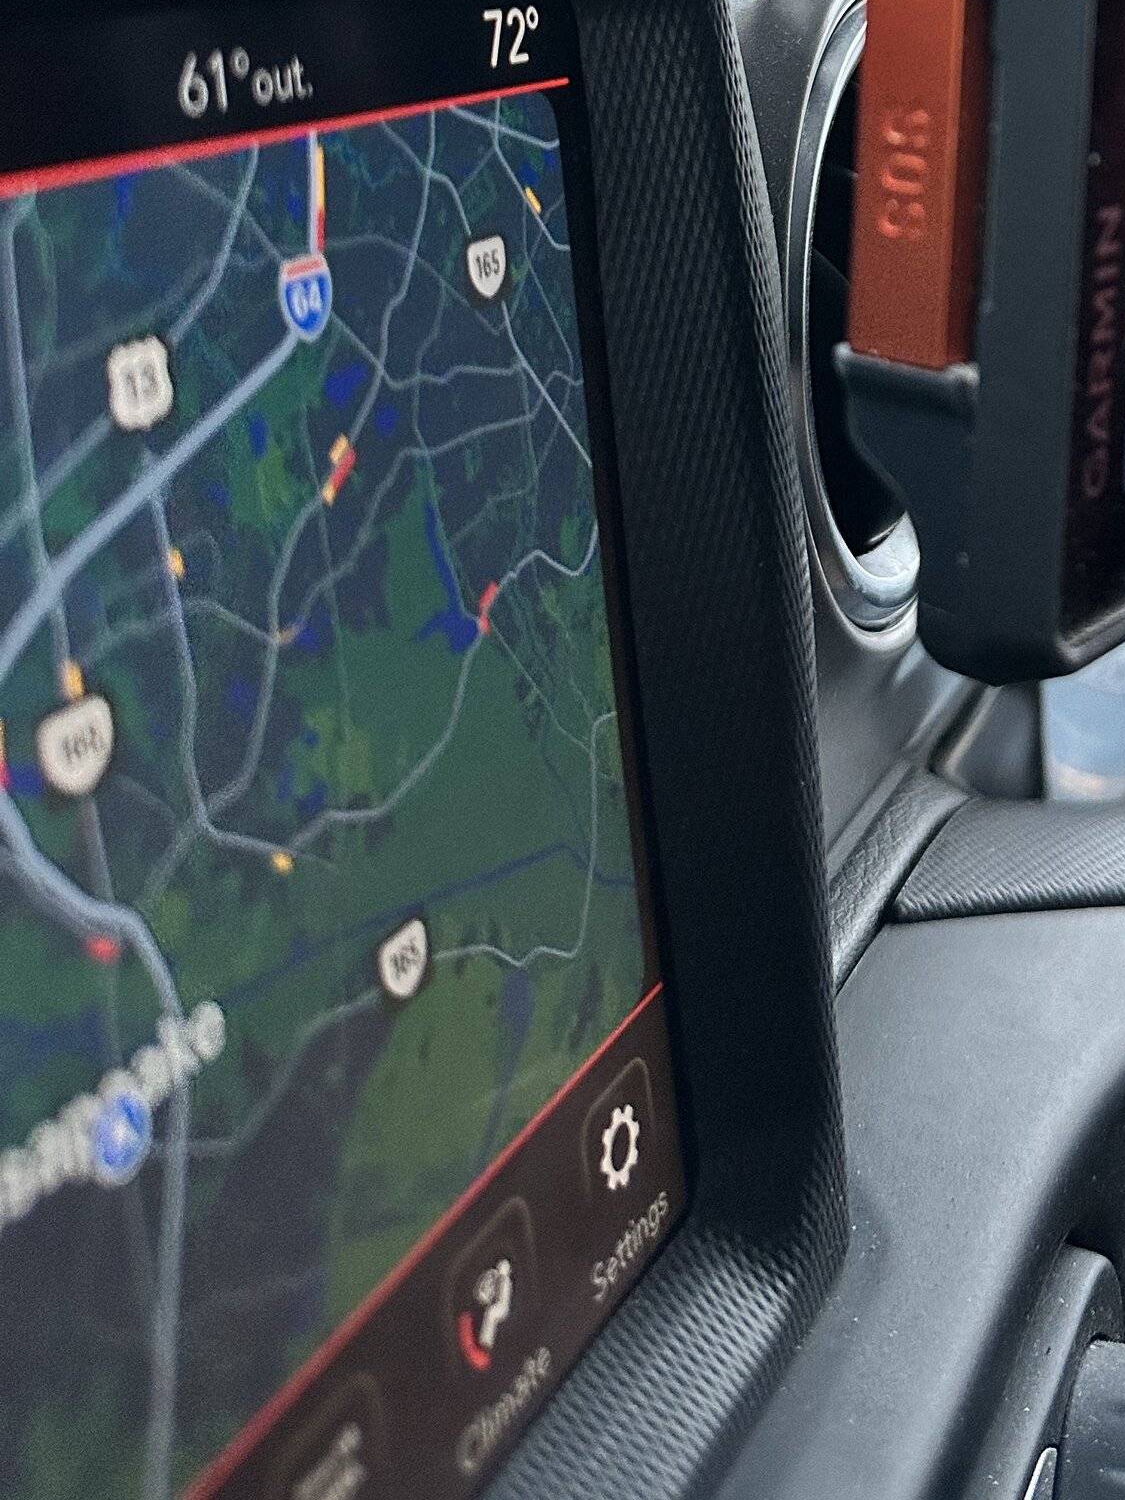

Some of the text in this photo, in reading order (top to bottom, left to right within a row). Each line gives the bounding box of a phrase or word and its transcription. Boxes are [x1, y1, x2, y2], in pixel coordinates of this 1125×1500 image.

[483, 5, 540, 69] 72°
[292, 280, 322, 318] 64
[474, 250, 502, 277] 165
[1081, 202, 1122, 500] GARMIN
[591, 1191, 669, 1301] Settings
[456, 1347, 551, 1476] Climate
